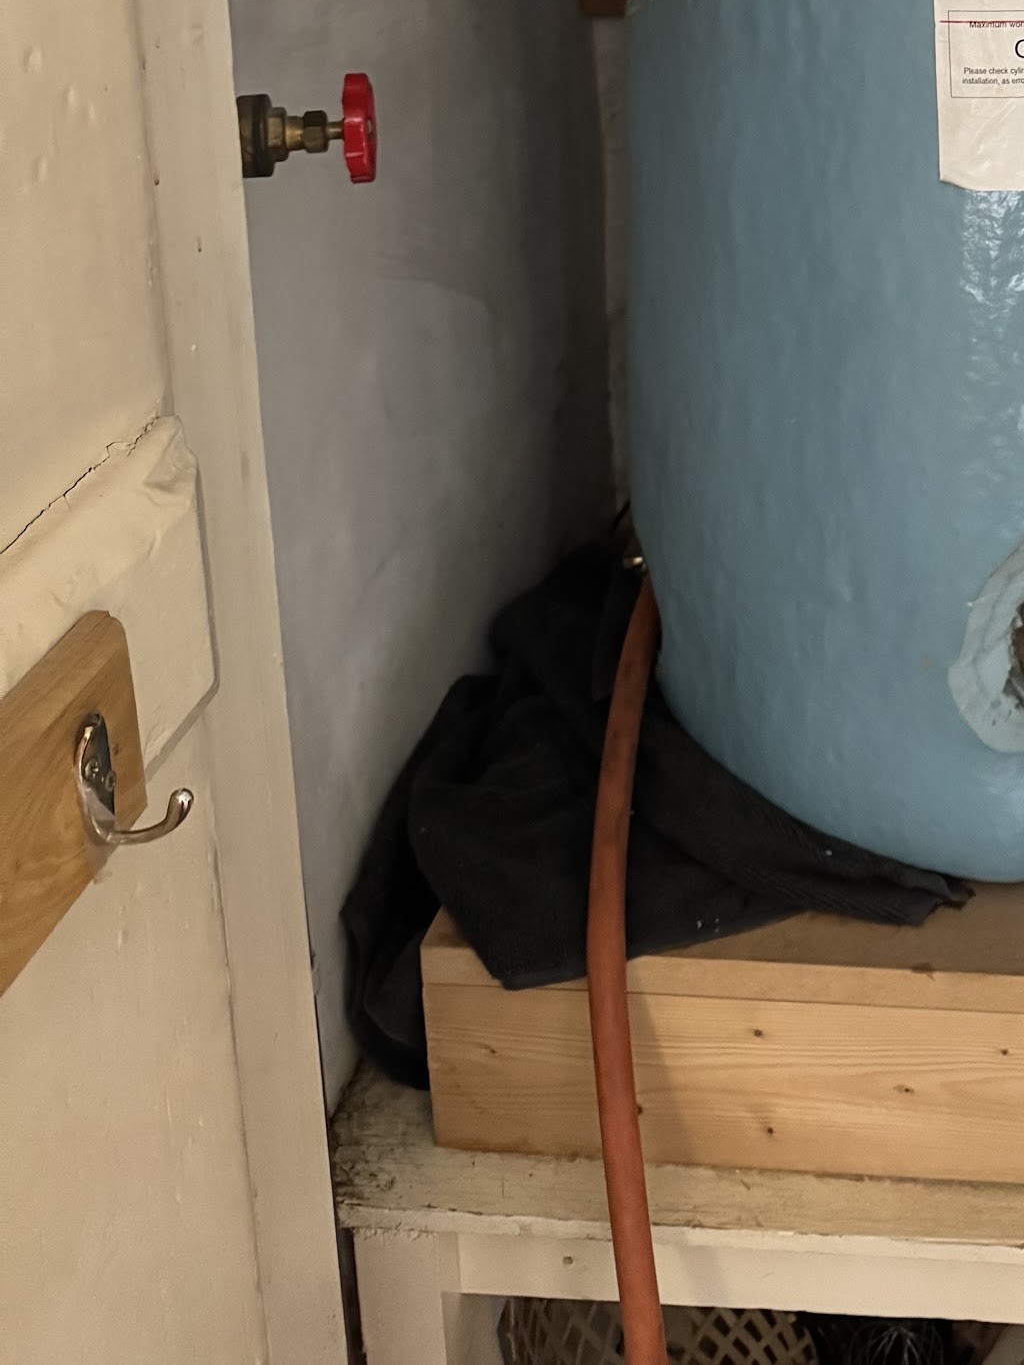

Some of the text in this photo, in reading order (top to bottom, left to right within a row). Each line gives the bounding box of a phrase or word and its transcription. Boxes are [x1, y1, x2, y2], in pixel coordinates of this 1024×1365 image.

[963, 67, 987, 75] Please
[988, 67, 1008, 75] check
[962, 77, 1000, 86] installation,
